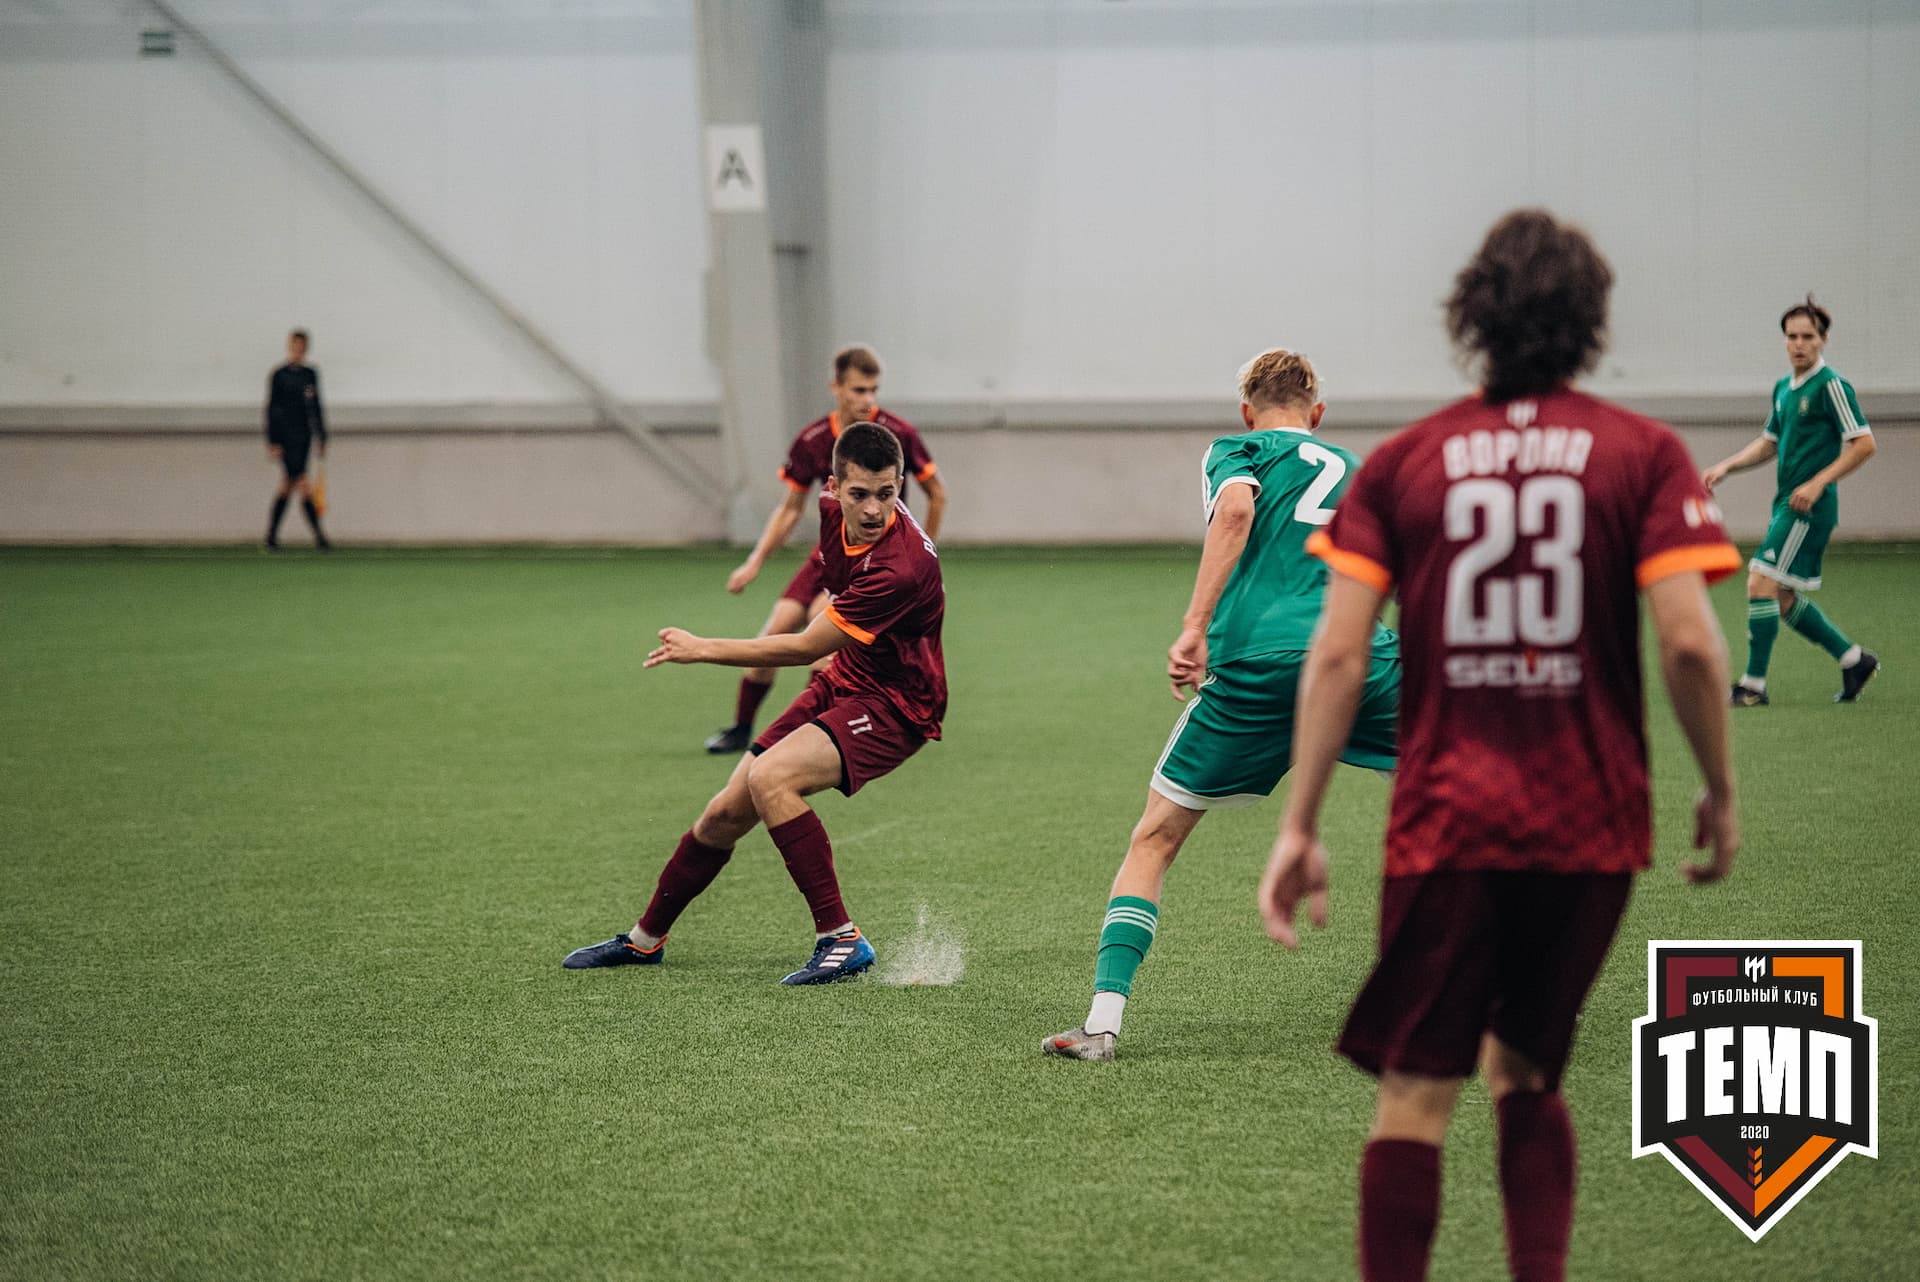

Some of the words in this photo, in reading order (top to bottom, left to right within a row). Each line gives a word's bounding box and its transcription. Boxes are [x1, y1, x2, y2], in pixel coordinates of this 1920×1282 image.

[716, 148, 754, 190] A
[1444, 475, 1585, 646] 23
[847, 714, 873, 735] 11
